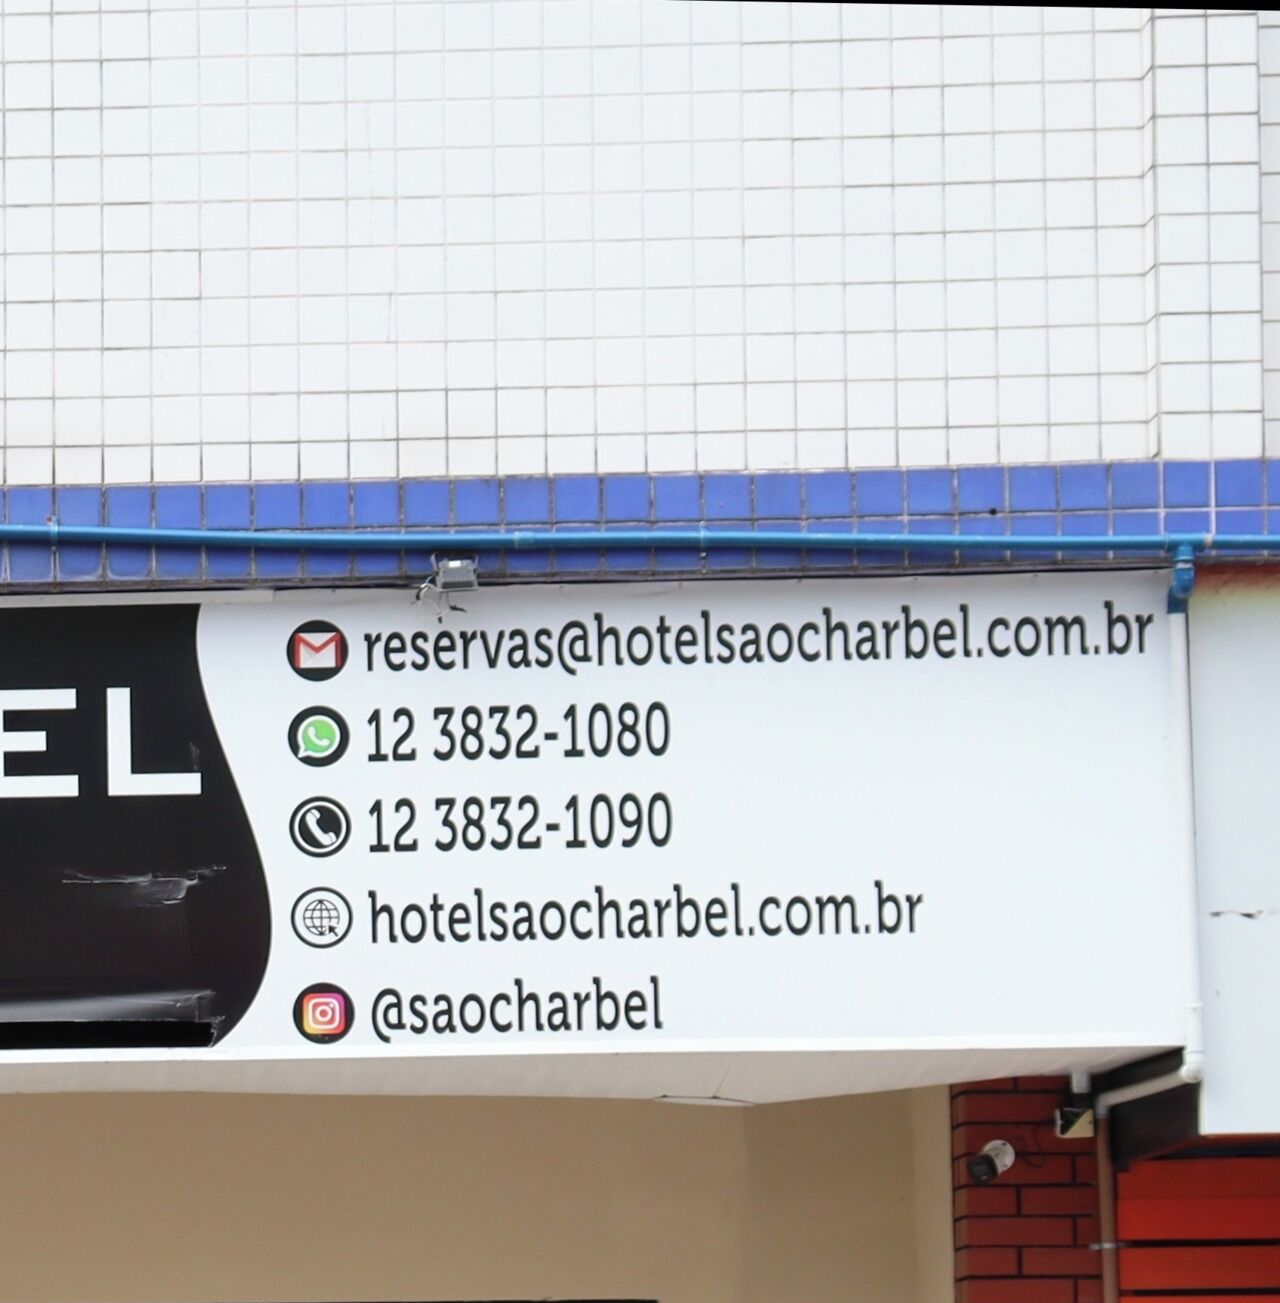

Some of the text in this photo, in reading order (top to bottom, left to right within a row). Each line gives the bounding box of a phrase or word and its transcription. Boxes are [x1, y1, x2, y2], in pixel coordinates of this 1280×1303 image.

[364, 600, 1154, 676] reservas@hotelsaocharbel.com.br
[367, 701, 669, 762] 12 3832-1080
[369, 792, 671, 853] 12 3832-1090
[368, 880, 922, 944] hotelsaocharbel.com.br
[371, 975, 662, 1043] @saocharbel
